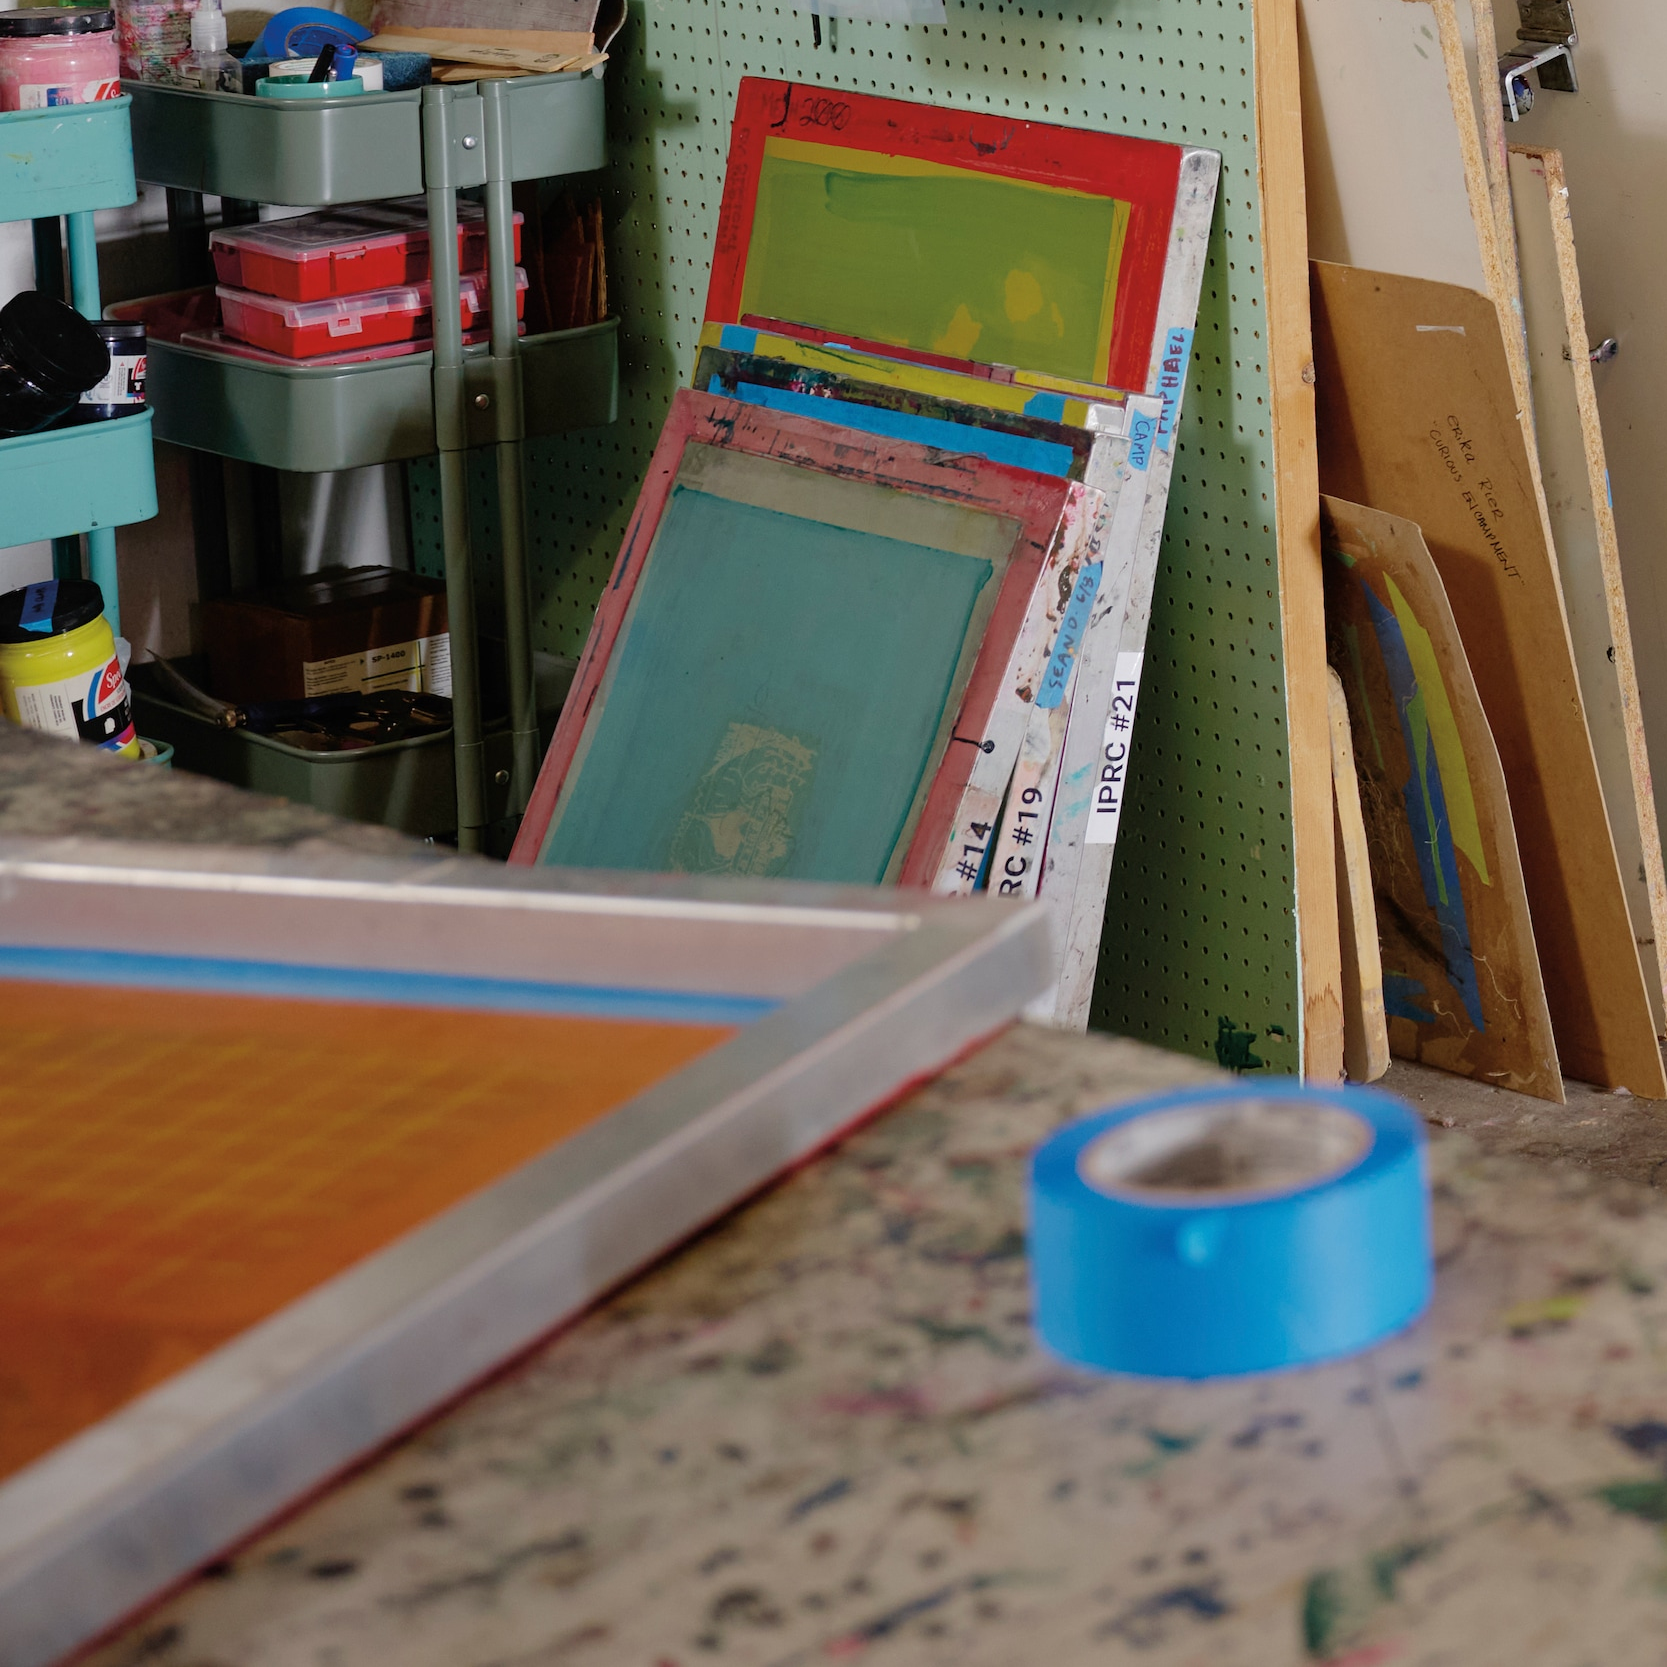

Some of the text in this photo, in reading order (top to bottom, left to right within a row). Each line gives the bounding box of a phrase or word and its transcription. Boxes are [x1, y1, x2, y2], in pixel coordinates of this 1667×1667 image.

[1131, 419, 1151, 467] CAMP
[1096, 678, 1137, 815] IPRC #21
[1011, 786, 1043, 847] #19
[955, 821, 993, 882] #14
